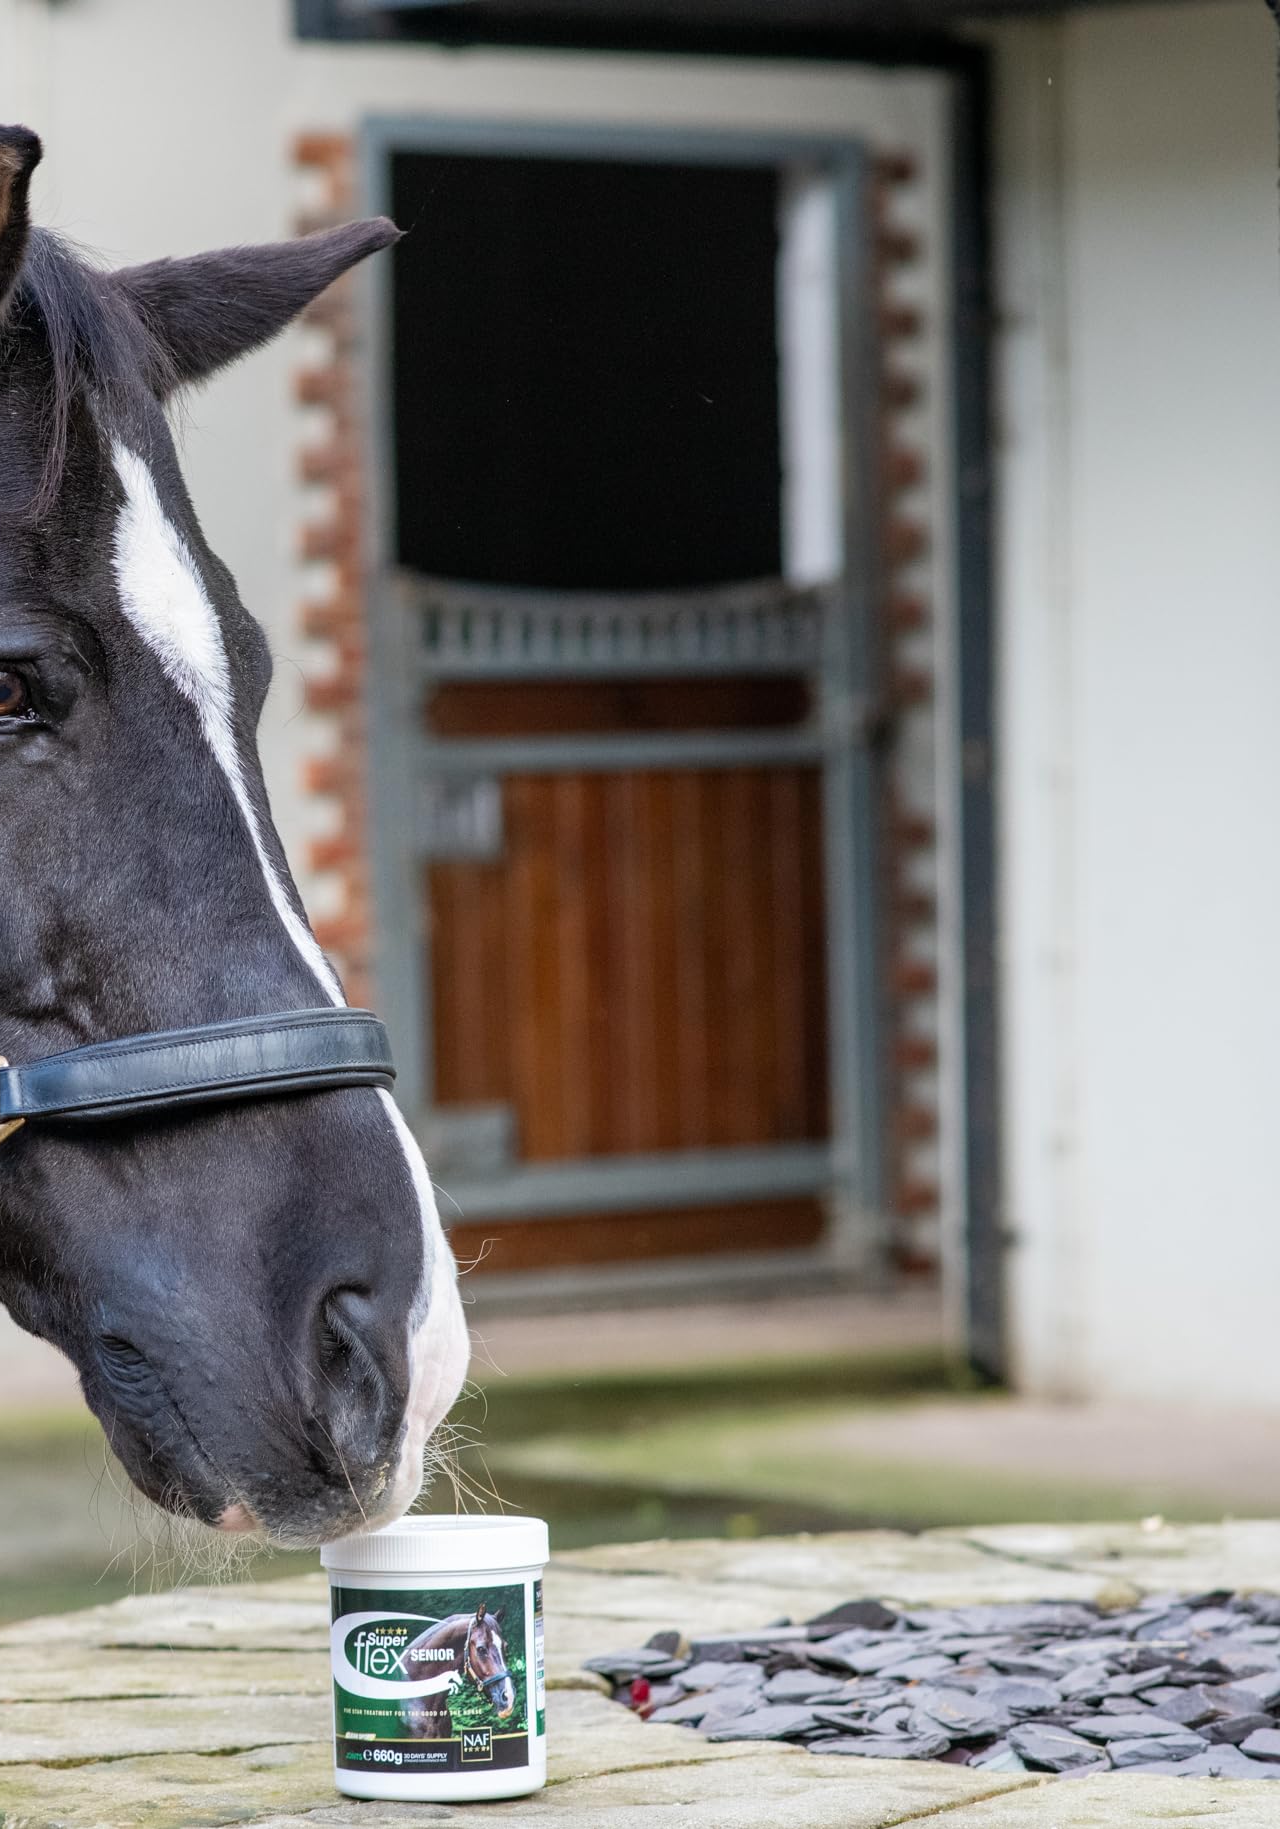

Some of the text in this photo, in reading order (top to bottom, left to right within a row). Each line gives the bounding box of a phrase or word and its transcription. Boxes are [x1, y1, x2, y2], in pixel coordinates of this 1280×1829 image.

[367, 1632, 408, 1649] Super
[353, 1631, 410, 1675] flex
[410, 1648, 455, 1662] SENIOR
[363, 1709, 393, 1717] TREATMENT
[463, 1708, 483, 1716] HORSE
[463, 1733, 490, 1747] NAF
[373, 1749, 403, 1765] 660g
